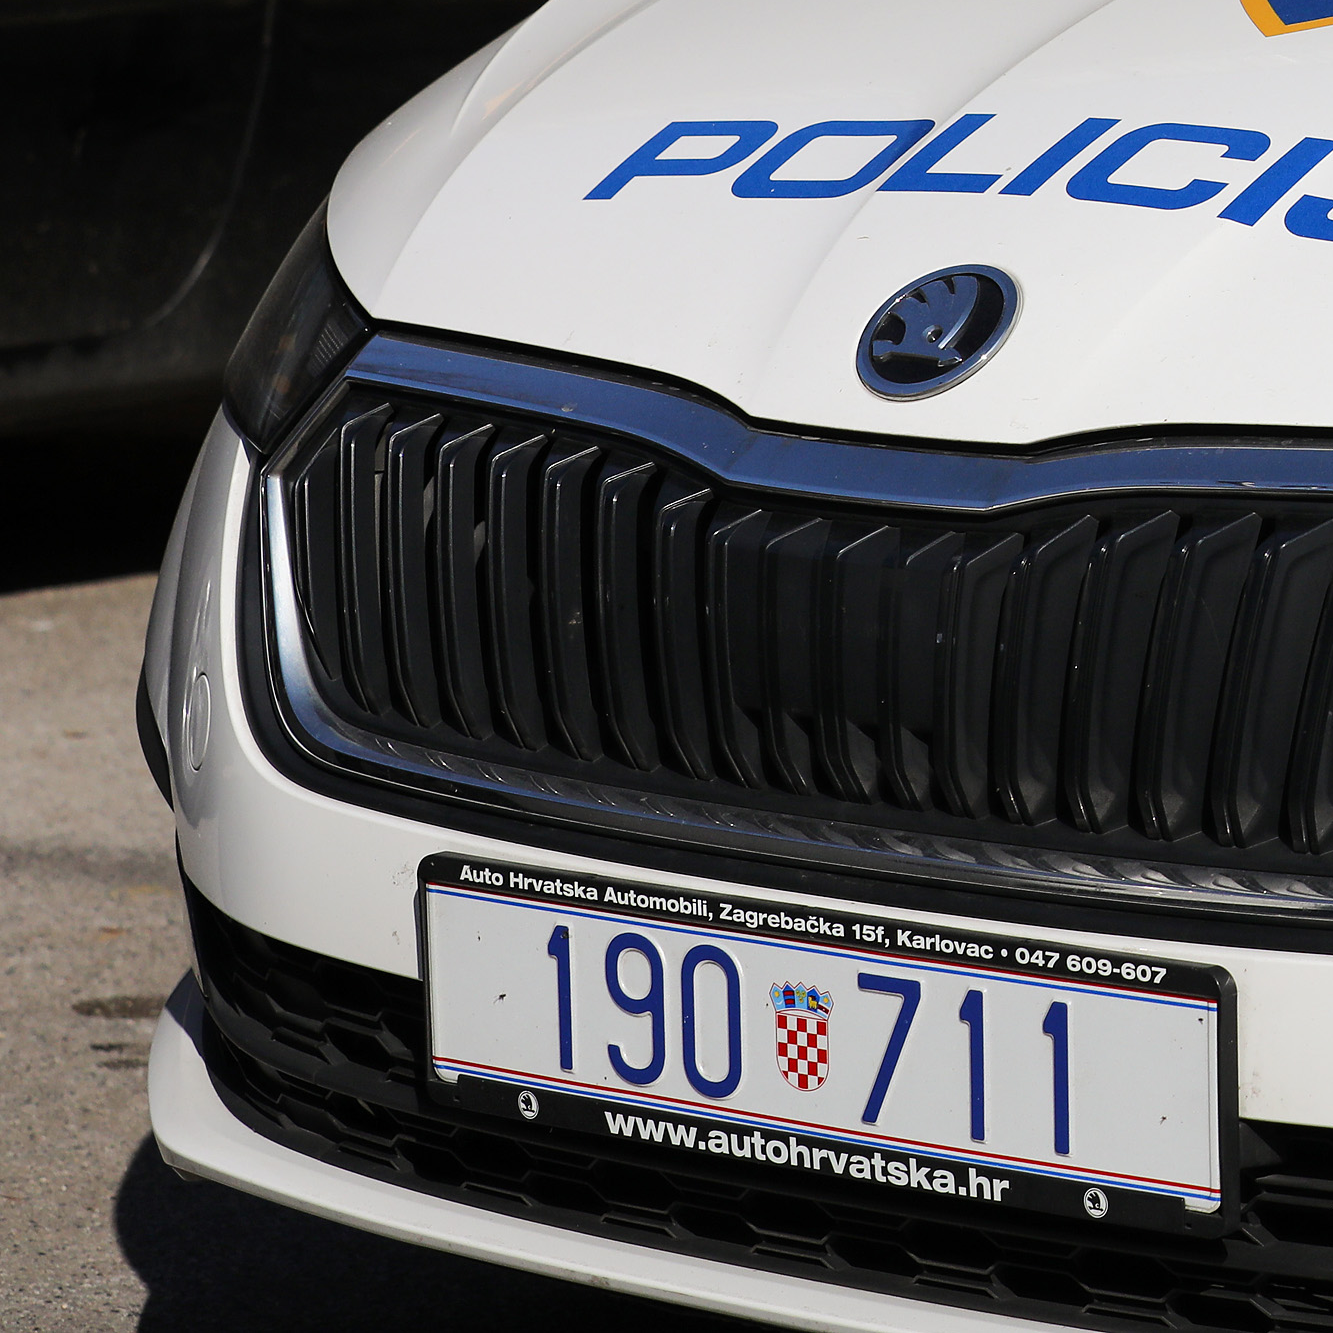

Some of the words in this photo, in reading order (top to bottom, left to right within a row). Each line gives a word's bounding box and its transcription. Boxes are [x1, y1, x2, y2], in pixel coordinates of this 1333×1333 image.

[459, 864, 504, 886] Auto
[509, 871, 599, 902] Hrvatska
[603, 886, 714, 922] Automobili,
[719, 901, 845, 938] Zagrebačka
[851, 923, 890, 949] 15f,
[896, 929, 994, 961] Karlovac
[1015, 947, 1060, 969] 047
[1066, 954, 1167, 985] 609-607
[547, 925, 742, 1099] 190
[857, 972, 1070, 1156] 711
[604, 1111, 1010, 1202] www.autohrvatska.hr
